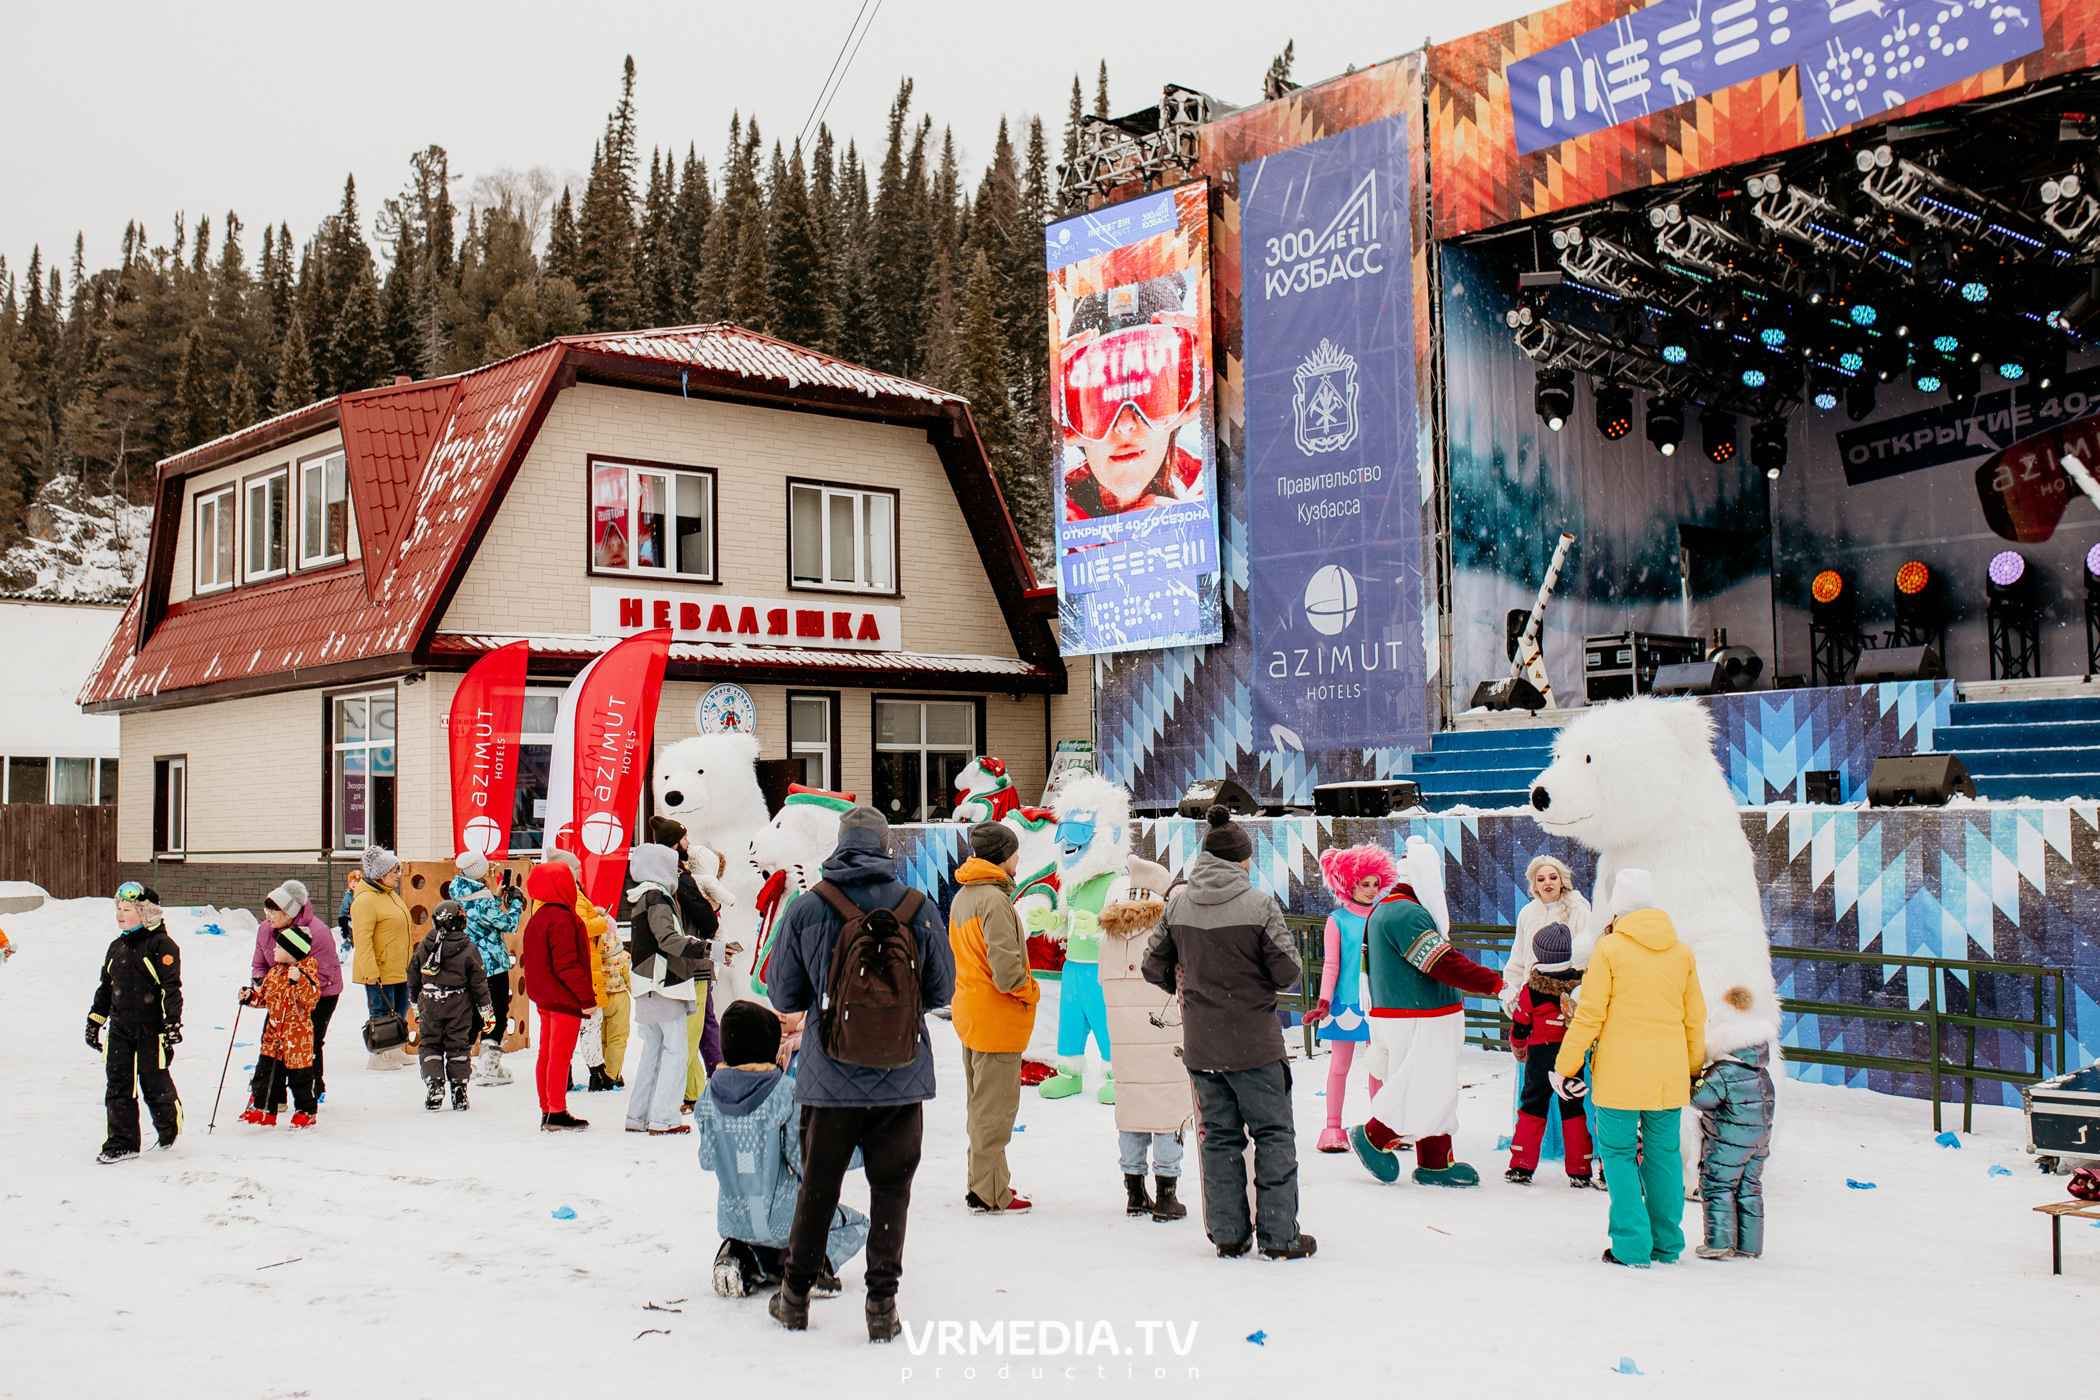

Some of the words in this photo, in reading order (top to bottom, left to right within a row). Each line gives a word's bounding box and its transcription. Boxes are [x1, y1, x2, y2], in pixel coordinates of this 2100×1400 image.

[1265, 228, 1315, 267] 300
[1265, 242, 1384, 300] КУЗБАСС
[1103, 380, 1151, 402] HOTELS
[1848, 404, 2033, 464] ОТКРЫТИЕ
[1277, 465, 1382, 499] Правительство
[1062, 522, 1124, 541] ОТКРЫТИЕ
[1160, 509, 1211, 526] СЕЗОНА
[1297, 498, 1361, 526] Кузбасса
[619, 598, 881, 641] НЕВАЛЯШКА
[733, 689, 753, 712] school
[1307, 683, 1362, 701] HOTELS
[494, 738, 506, 780] HOTELS
[621, 730, 637, 774] HOTELS
